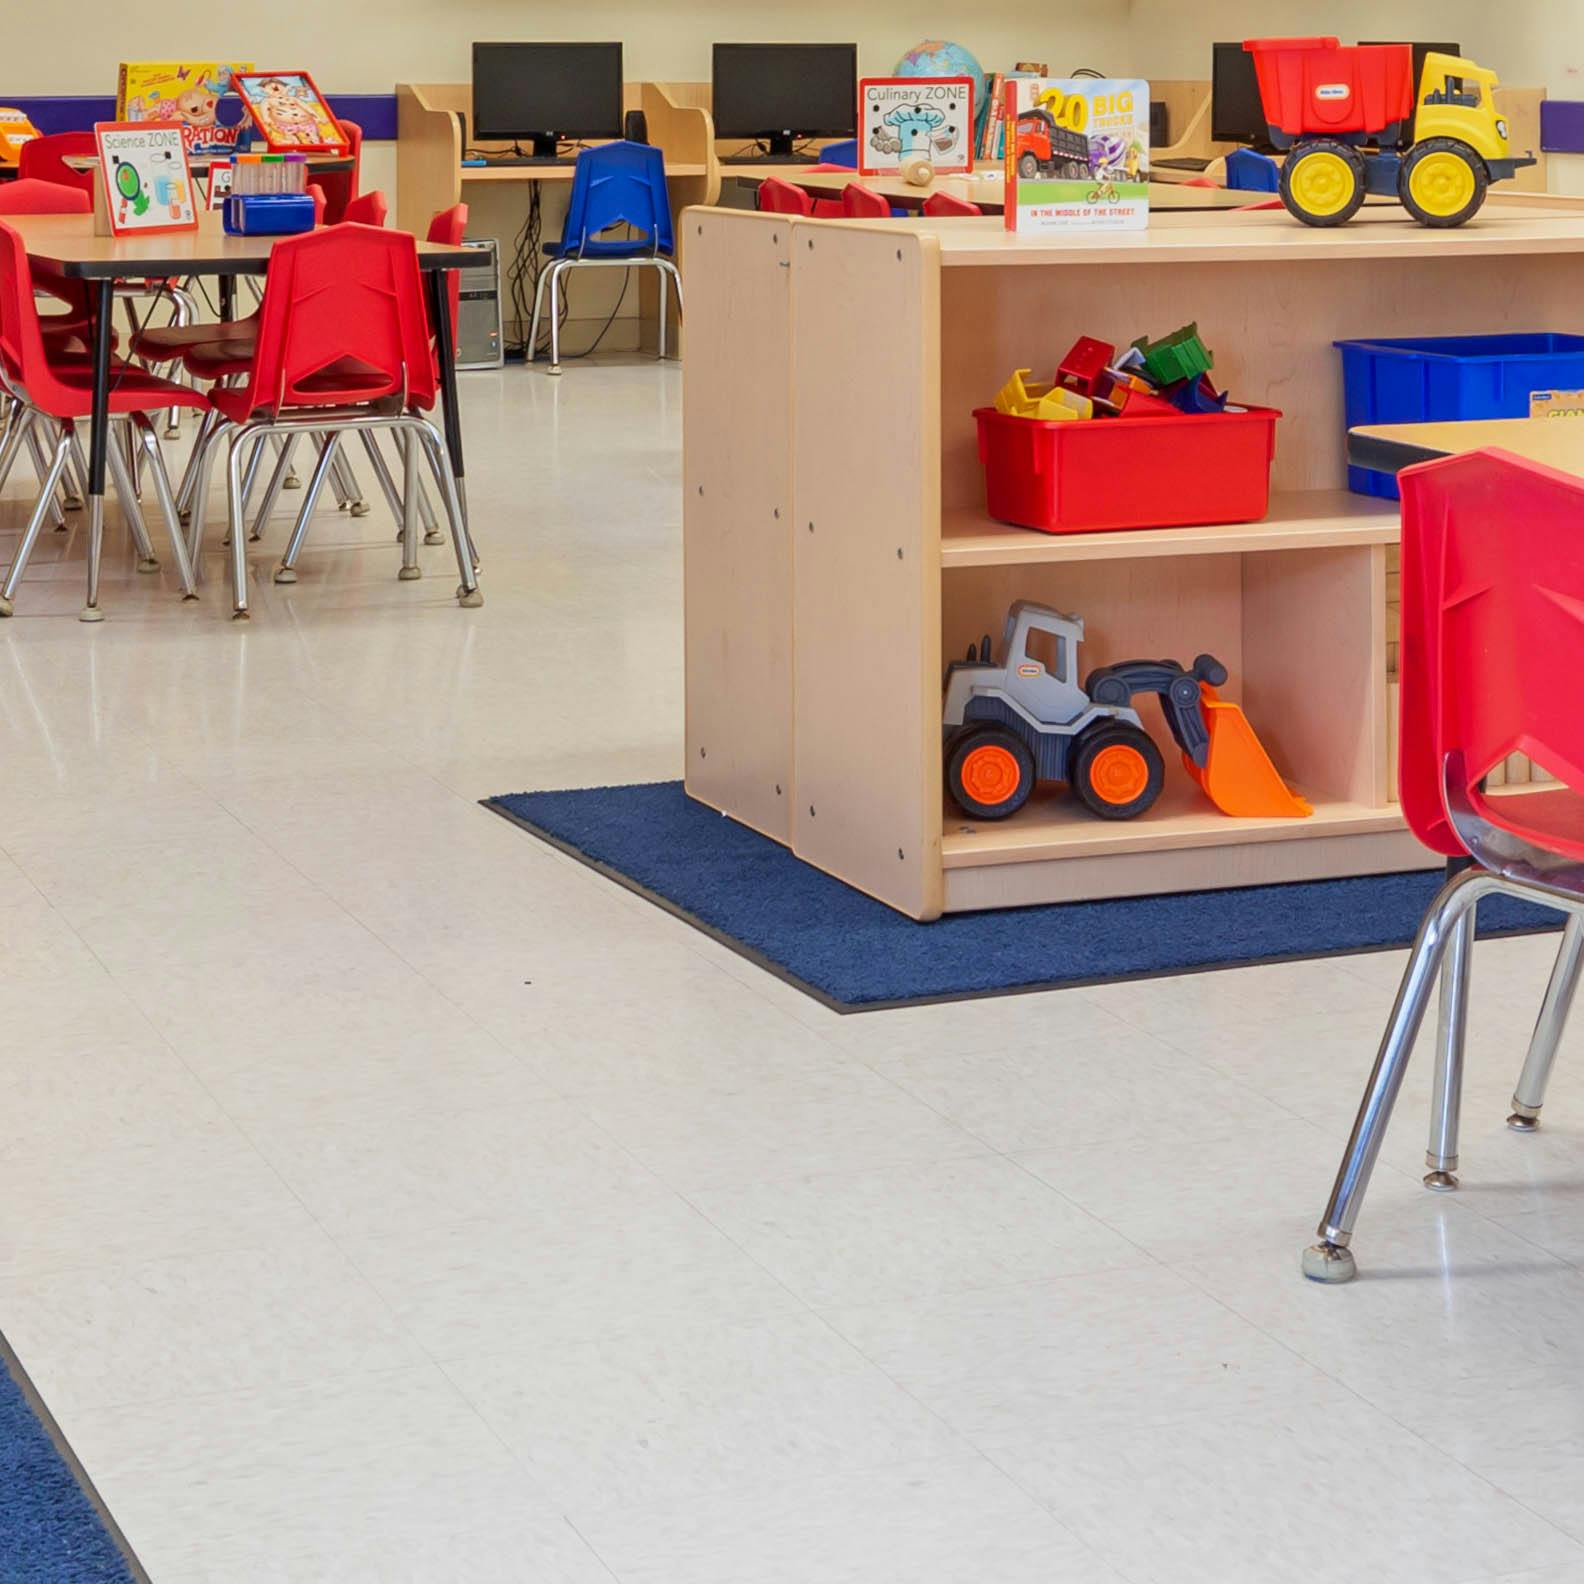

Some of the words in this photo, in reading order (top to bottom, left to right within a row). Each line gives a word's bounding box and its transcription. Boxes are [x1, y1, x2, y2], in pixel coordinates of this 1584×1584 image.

[867, 87, 922, 103] Culinary
[925, 86, 967, 100] ZONE
[1093, 90, 1134, 116] BIG
[1039, 87, 1089, 133] 20
[104, 134, 146, 149] Science
[147, 131, 179, 148] ZONE
[182, 126, 241, 148] RATION
[1041, 208, 1053, 217] THE
[1082, 208, 1091, 217] OF
[1095, 207, 1107, 216] THE
[1109, 207, 1136, 216] STREET
